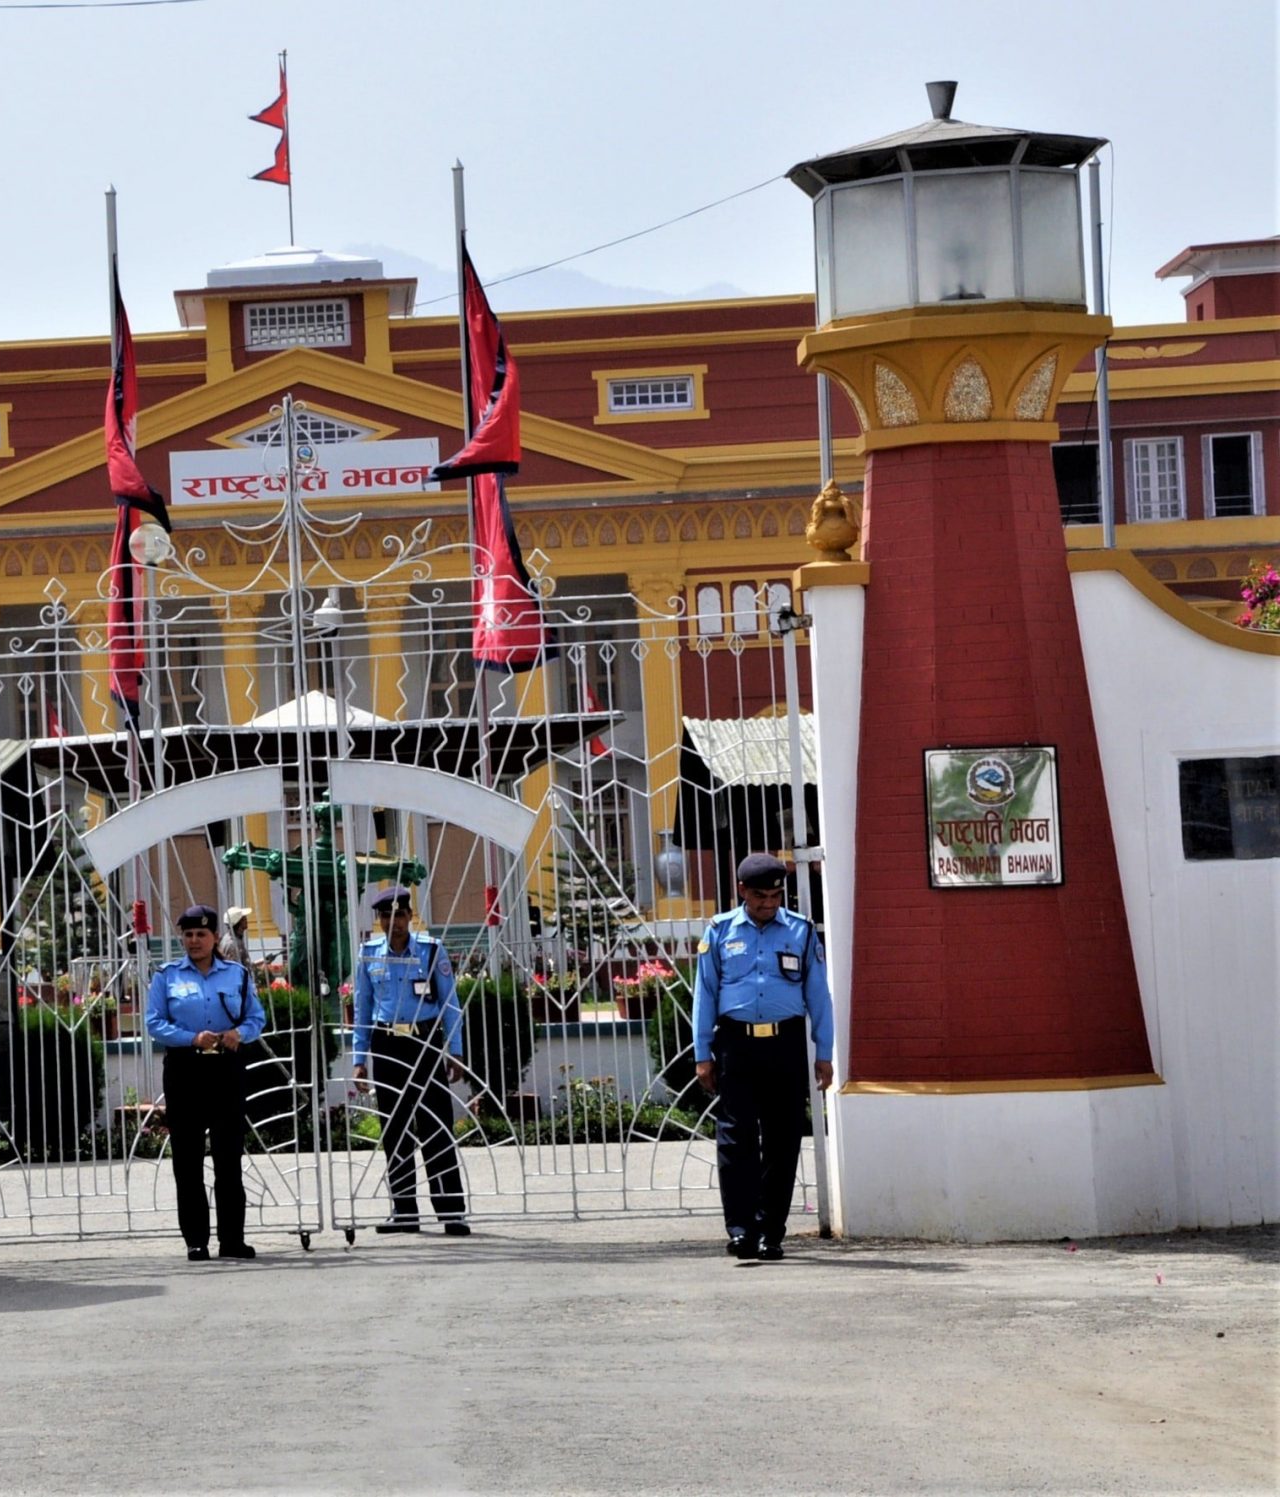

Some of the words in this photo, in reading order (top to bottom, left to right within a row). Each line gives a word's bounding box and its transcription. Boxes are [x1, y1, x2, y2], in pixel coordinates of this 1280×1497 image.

[342, 465, 432, 489] भवन
[936, 809, 1003, 852] राष्ट्रपति
[1009, 818, 1050, 843] भवन
[937, 855, 1001, 876] RASTRAPATI
[1007, 854, 1053, 873] BHAWAN
